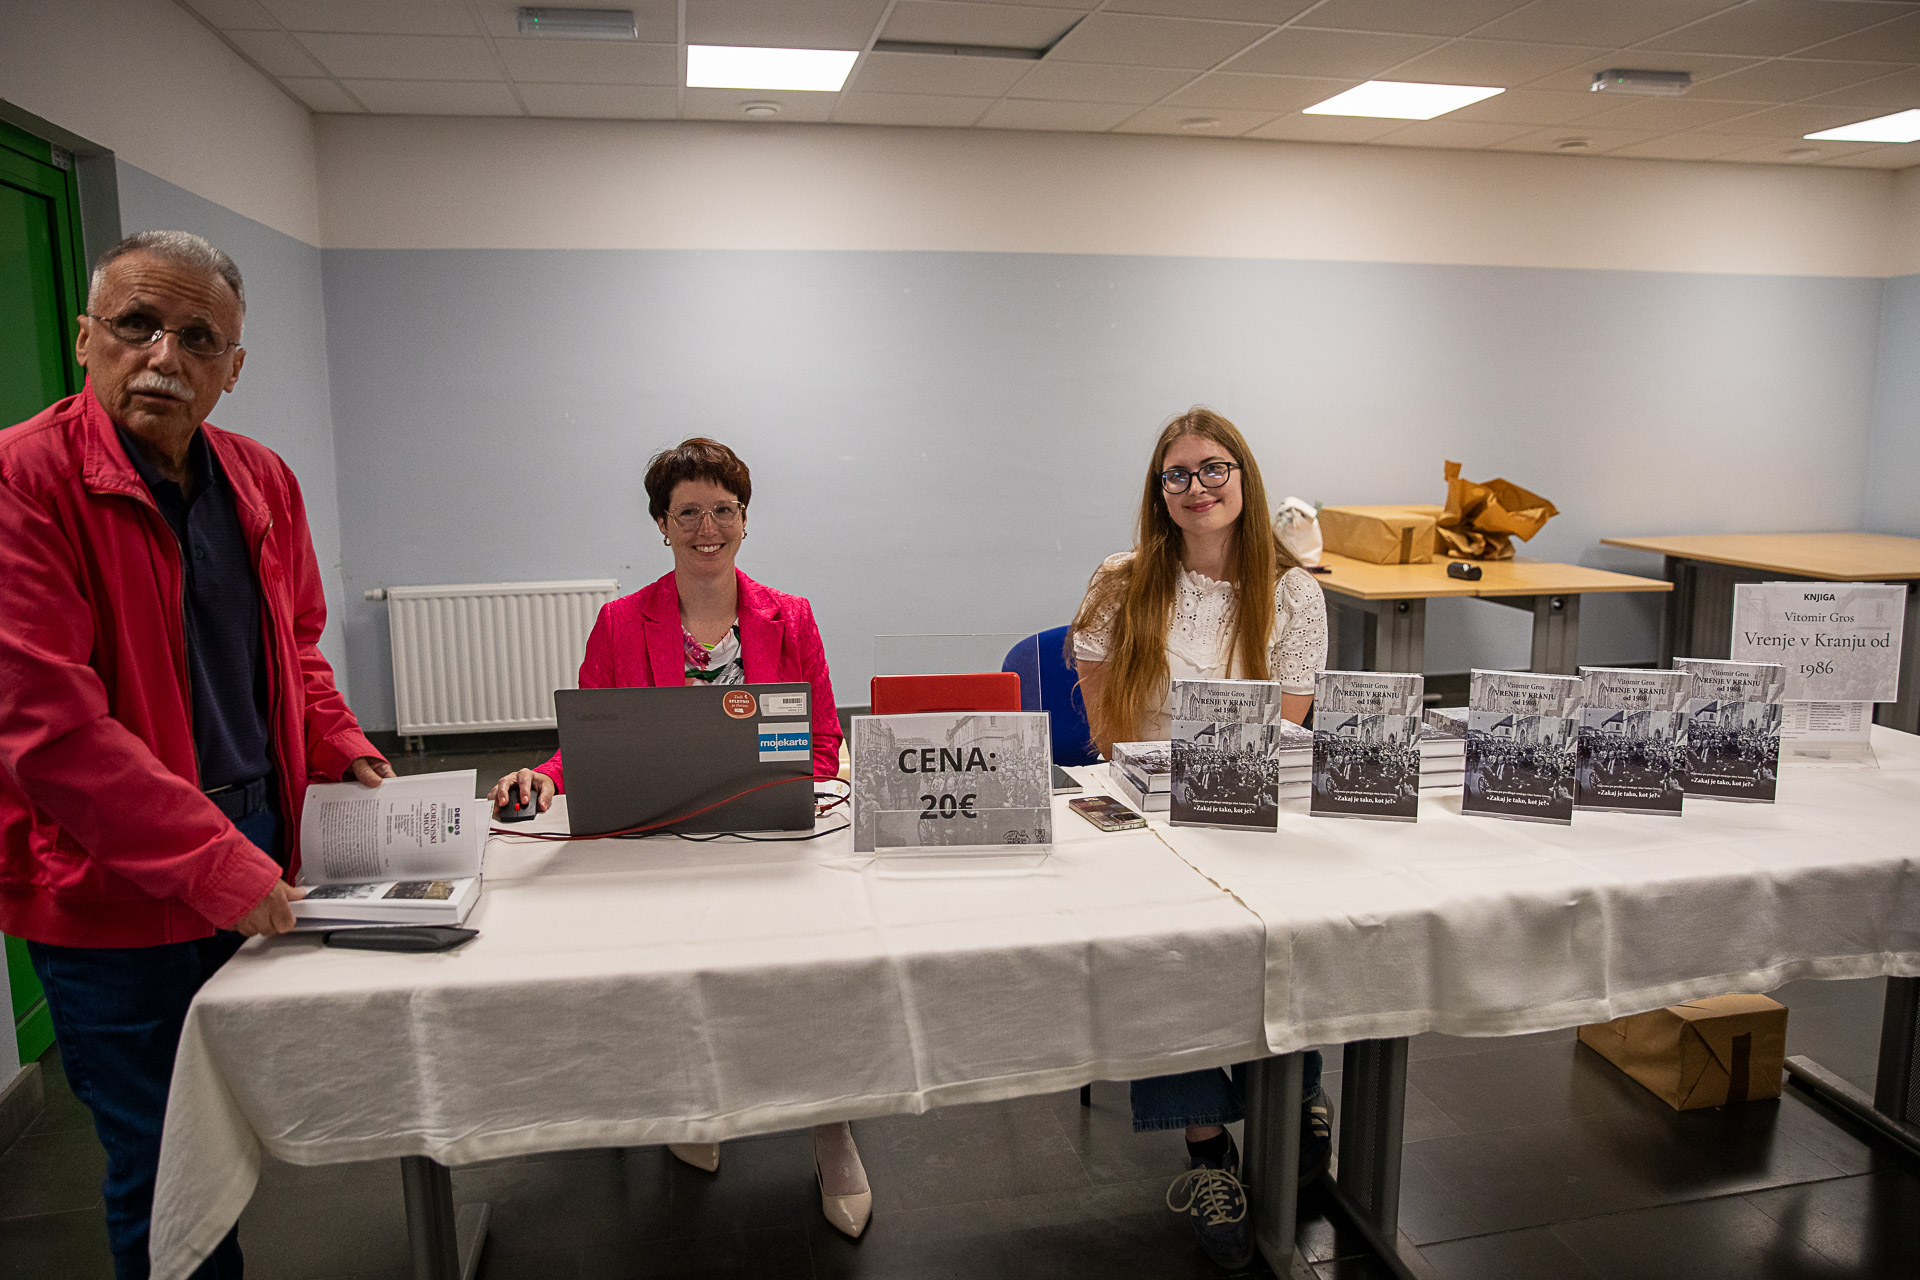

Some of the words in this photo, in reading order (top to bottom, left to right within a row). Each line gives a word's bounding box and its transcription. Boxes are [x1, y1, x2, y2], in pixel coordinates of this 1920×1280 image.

[1803, 593, 1836, 602] KNJIGA
[1784, 611, 1827, 622] Vitomir
[1829, 612, 1855, 623] Gros
[1744, 631, 1796, 651] Vrenje
[1800, 638, 1810, 647] v
[1815, 633, 1867, 652] Kranju
[1870, 632, 1890, 648] od
[1800, 660, 1834, 678] 1986
[1507, 681, 1529, 689] Vitomir
[1699, 677, 1725, 685] VRENJE
[1732, 679, 1761, 687] KRANJU
[1207, 689, 1230, 697] Vitomir
[1372, 691, 1400, 699] KRANJU
[1494, 689, 1520, 698] VRENJE
[1528, 692, 1556, 700] KRANJU
[1605, 686, 1631, 694] VRENJE
[1229, 699, 1257, 707] KRANJU
[760, 735, 808, 750] mojekarte
[899, 747, 997, 773] CENA:
[920, 793, 978, 820] 20€
